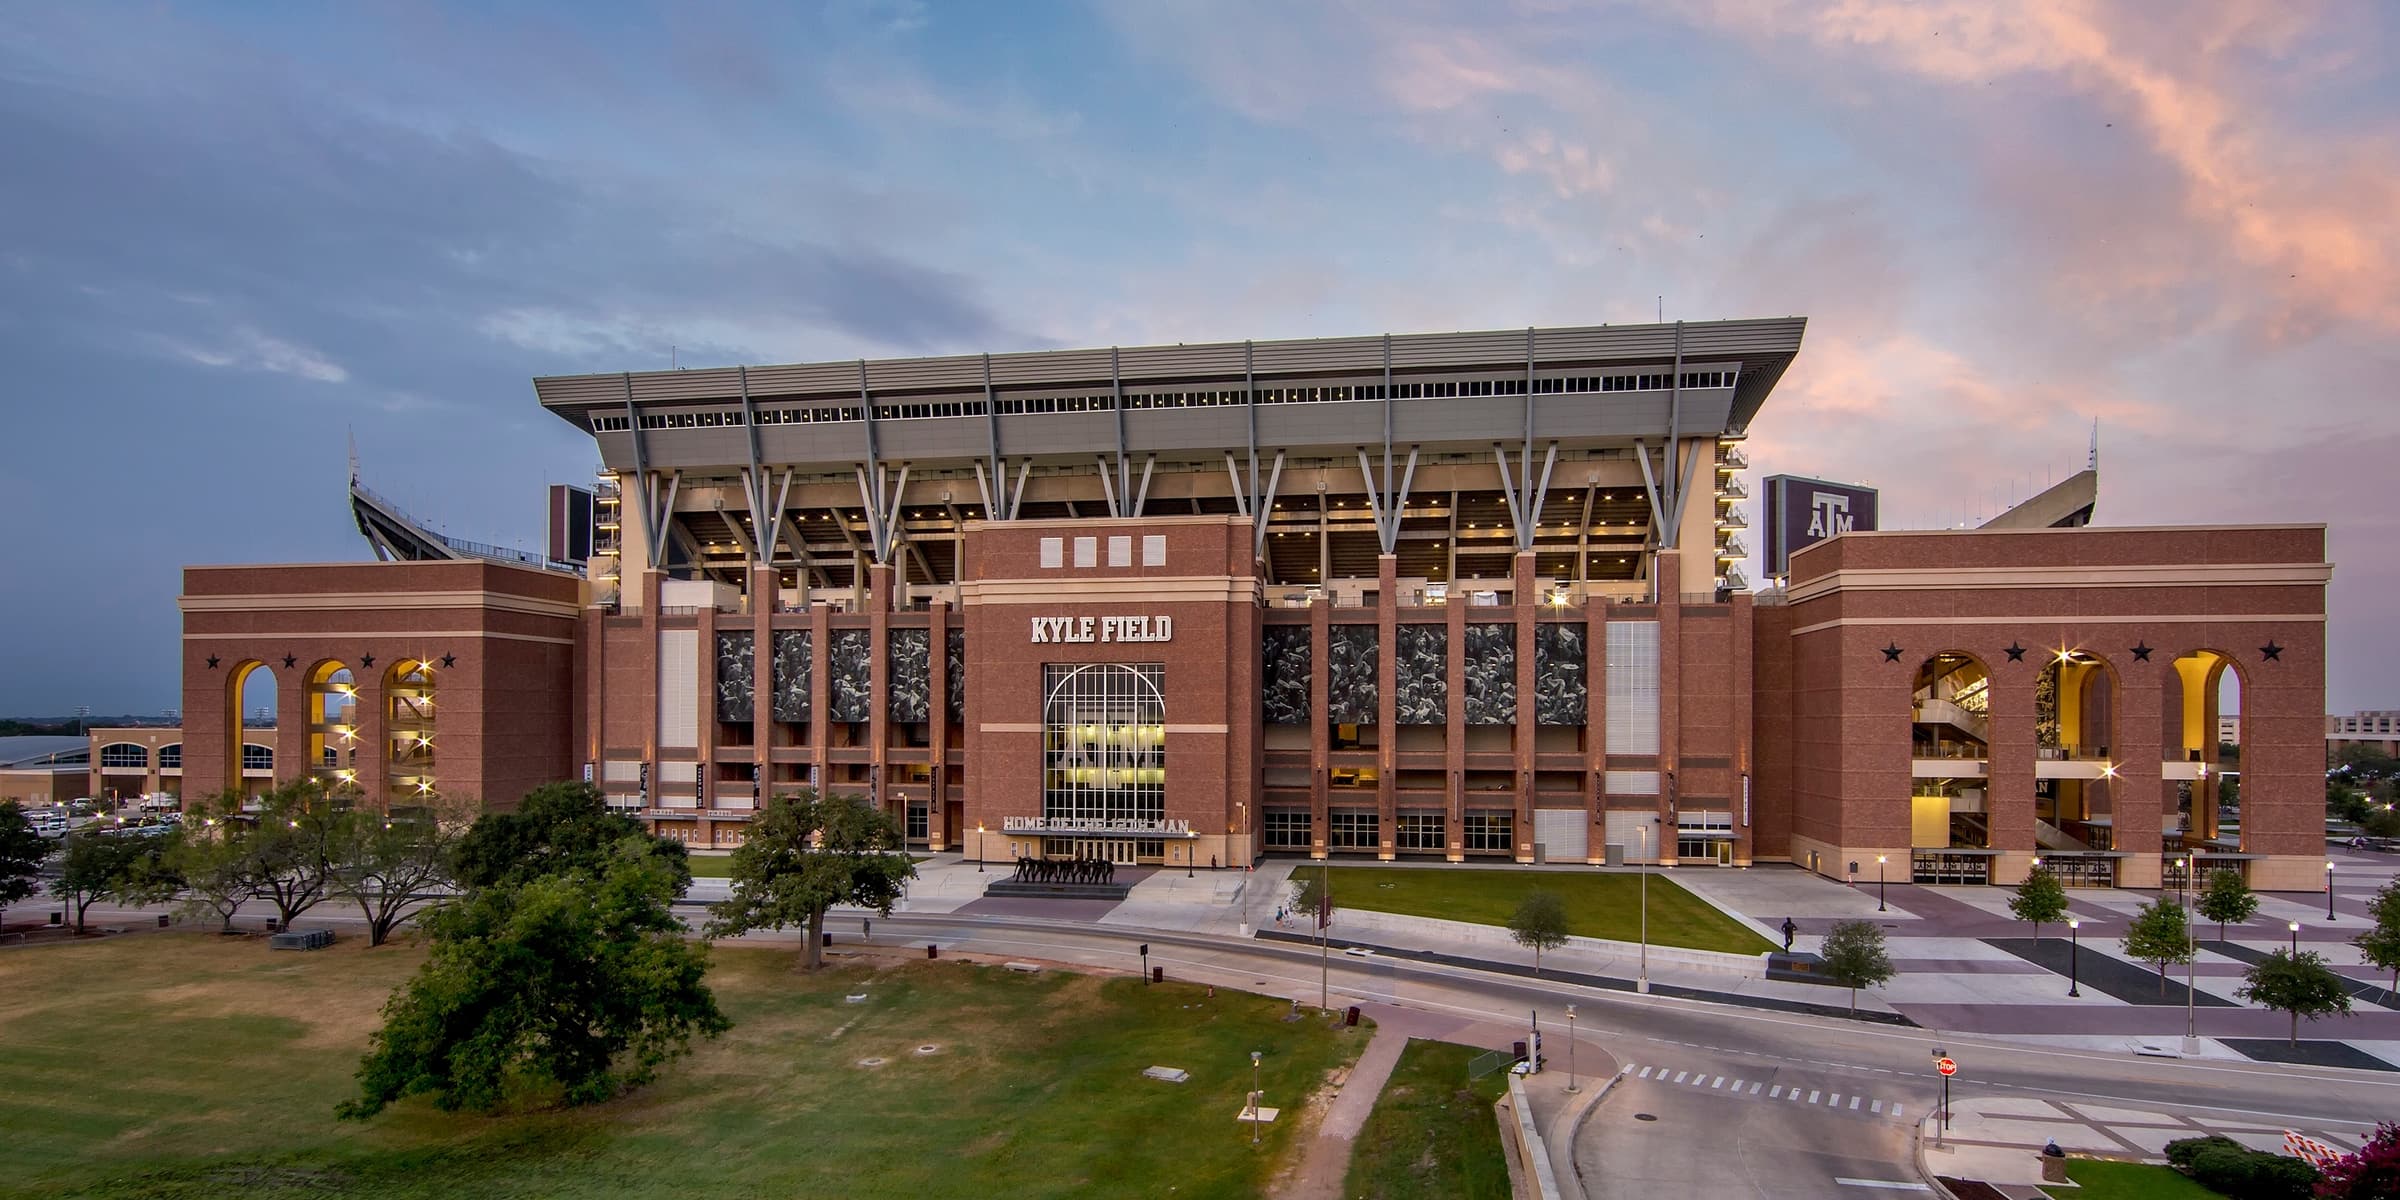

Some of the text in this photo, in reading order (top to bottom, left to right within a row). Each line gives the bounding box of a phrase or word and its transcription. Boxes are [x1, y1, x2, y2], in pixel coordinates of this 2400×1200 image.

[1031, 615, 1172, 643] KYLE FIELD
[1003, 816, 1190, 833] HOME OF THE 12TH MAN
